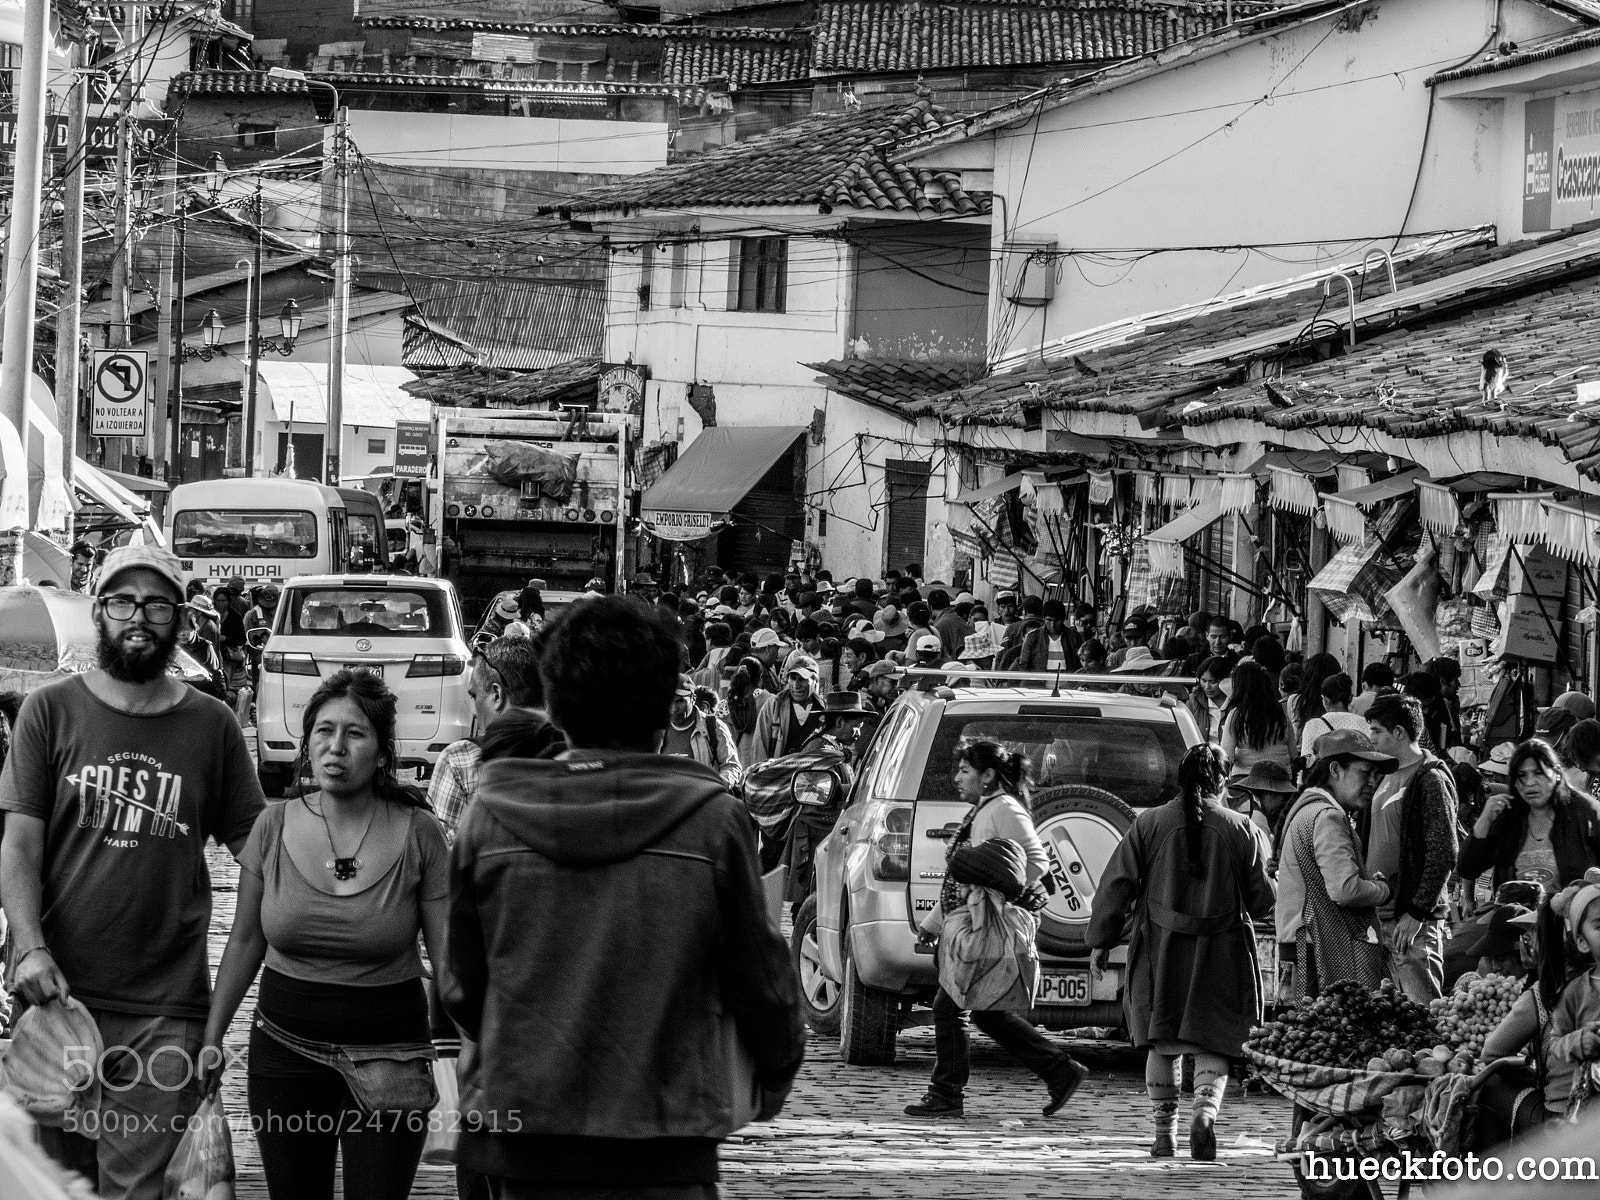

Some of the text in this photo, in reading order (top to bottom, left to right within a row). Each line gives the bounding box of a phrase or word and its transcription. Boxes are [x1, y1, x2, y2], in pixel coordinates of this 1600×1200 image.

[95, 407, 143, 416] NO VOLTEAR A
[96, 420, 143, 429] LA IZQUIERDA
[396, 464, 427, 473] PARADERO
[656, 512, 683, 527] EMPORIO
[209, 565, 281, 576] HYUNDAI
[107, 752, 162, 770] SEGUNDA
[103, 835, 139, 848] HARD
[1041, 840, 1081, 912] SUZUKI
